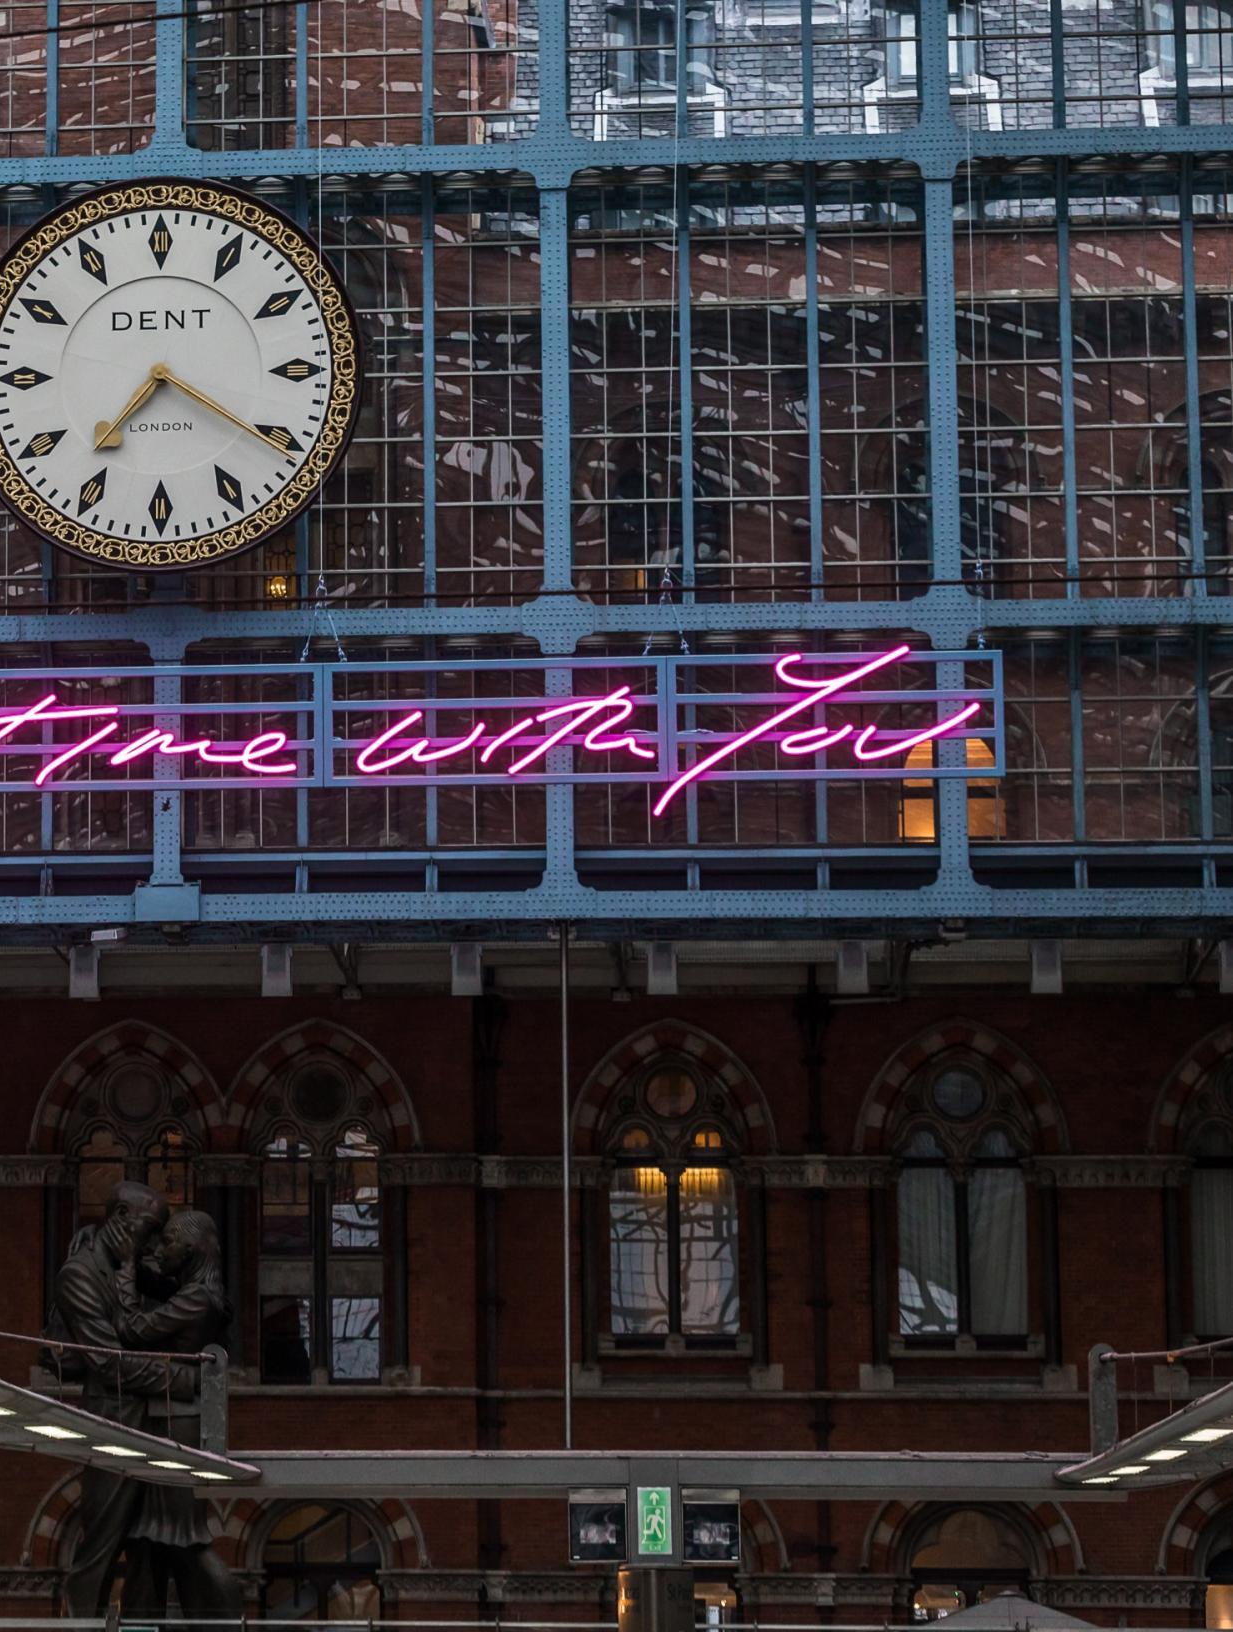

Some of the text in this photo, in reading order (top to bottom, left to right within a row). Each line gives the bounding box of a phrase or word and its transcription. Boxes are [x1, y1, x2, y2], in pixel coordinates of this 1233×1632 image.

[153, 231, 168, 252] XII
[83, 250, 102, 273] XI
[32, 304, 54, 319] X
[269, 296, 290, 312] II
[112, 309, 211, 331] DENT
[287, 365, 308, 376] III
[129, 422, 193, 433] LONDON
[653, 645, 981, 817] You
